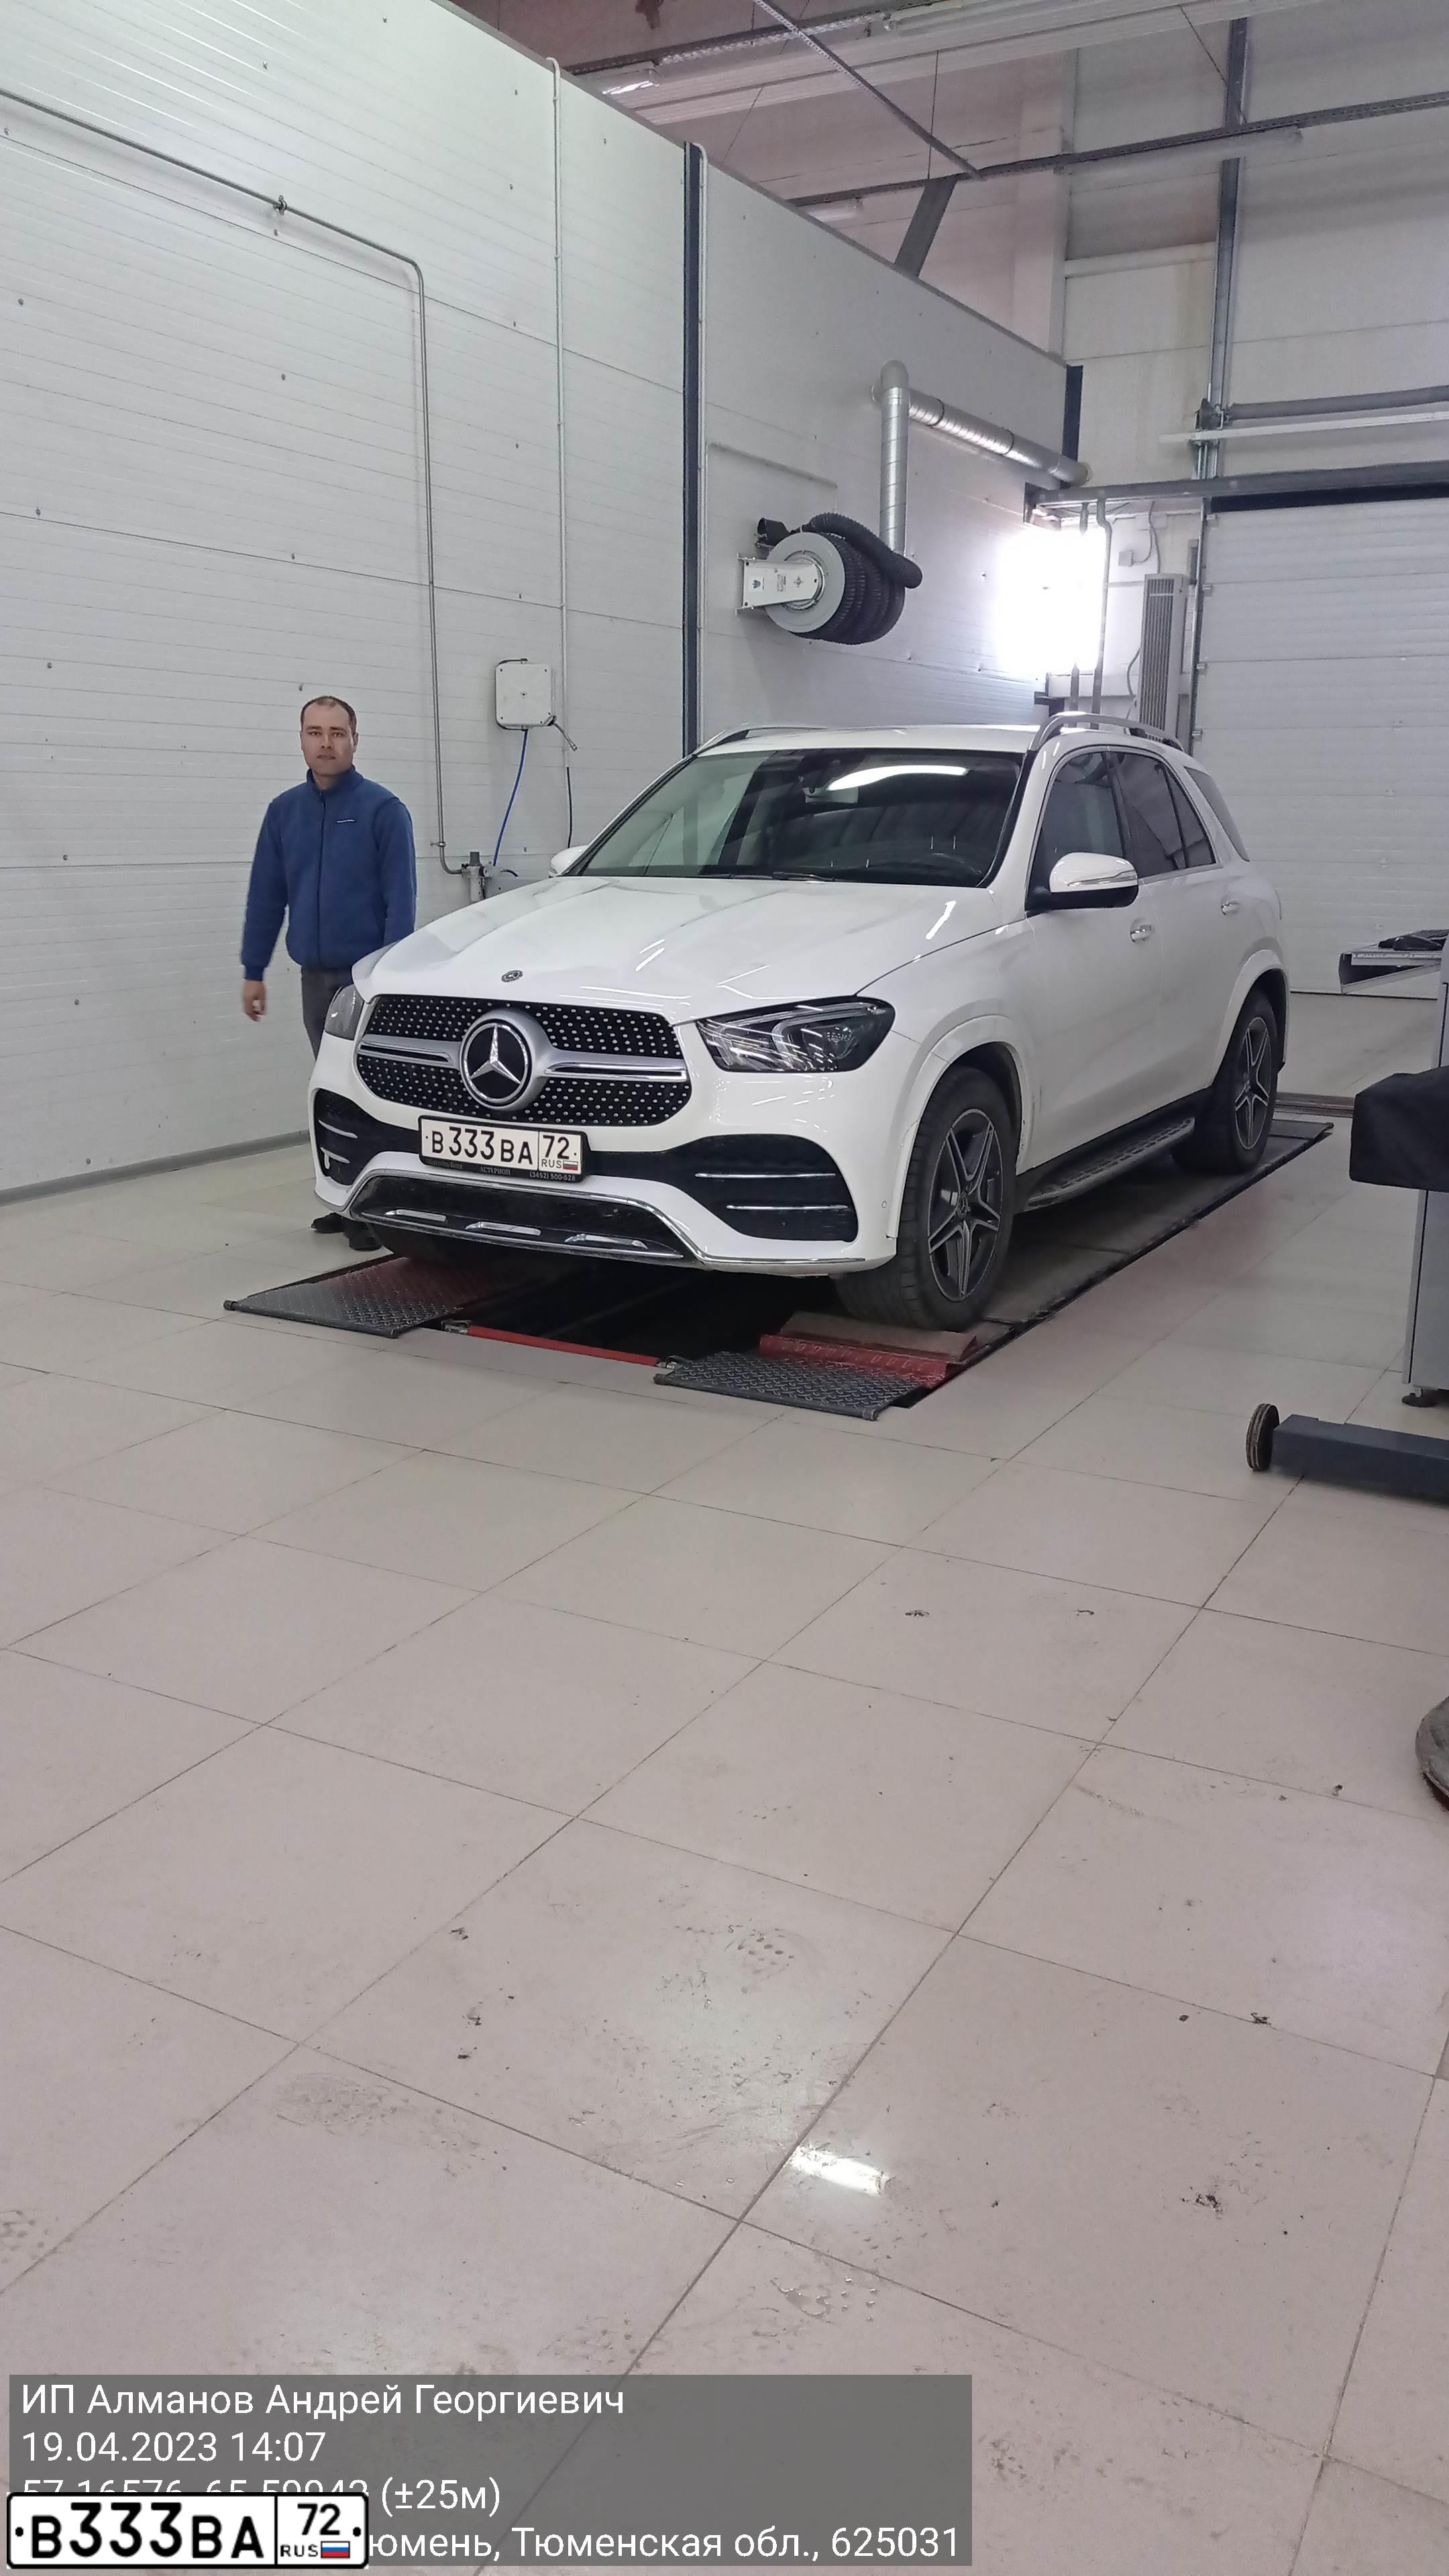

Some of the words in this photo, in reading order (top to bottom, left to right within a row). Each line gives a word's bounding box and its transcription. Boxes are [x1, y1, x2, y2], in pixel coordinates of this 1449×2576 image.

[431, 1126, 533, 1165] В333ВА
[543, 1134, 570, 1159] 72
[541, 1159, 562, 1169] RUS
